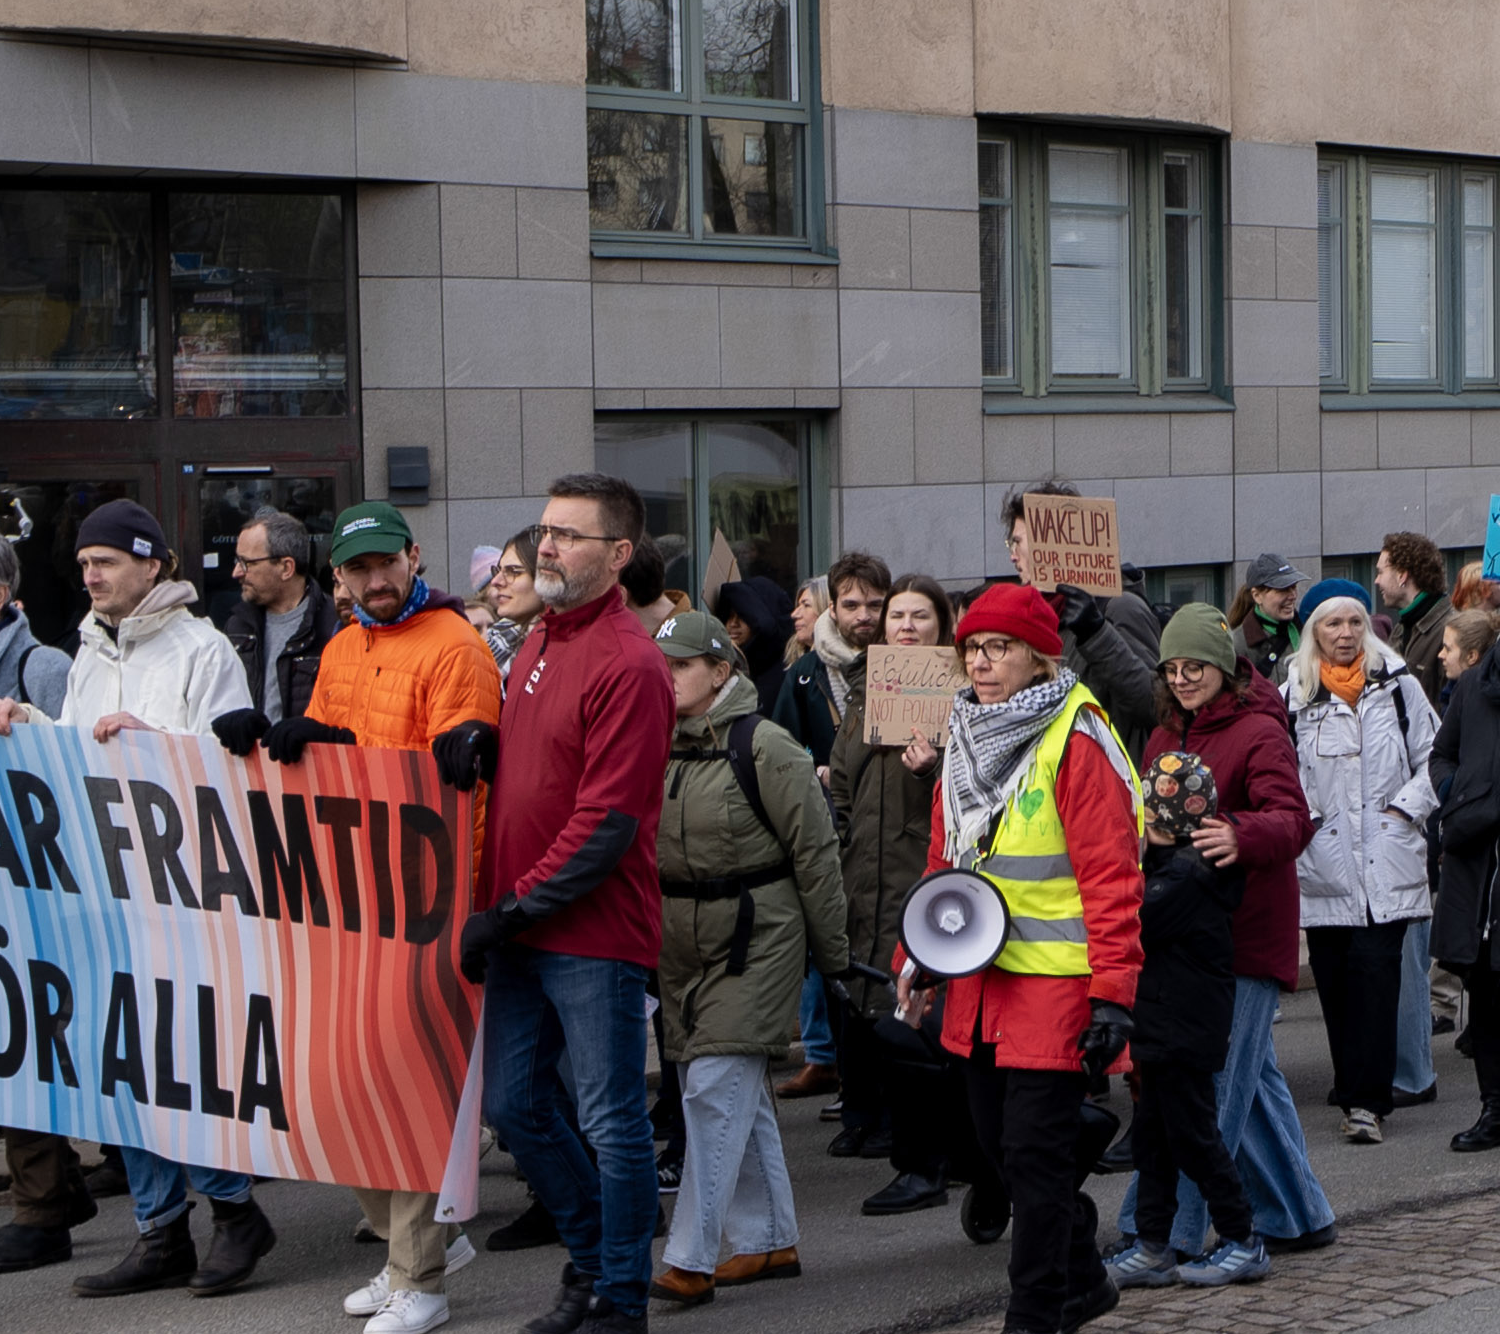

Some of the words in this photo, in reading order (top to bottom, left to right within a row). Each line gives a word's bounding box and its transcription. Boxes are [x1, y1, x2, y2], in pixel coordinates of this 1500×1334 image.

[1027, 507, 1080, 546] WAKE
[1081, 511, 1112, 549] UP!
[1032, 549, 1061, 567] OUR
[1065, 552, 1116, 570] FUTURE
[1033, 568, 1049, 582] IS
[1053, 570, 1117, 589] BURNING!!!
[524, 659, 547, 695] FOX
[870, 697, 897, 723] NOT
[83, 774, 454, 946] FRAMTID
[100, 971, 290, 1132] ALLA
